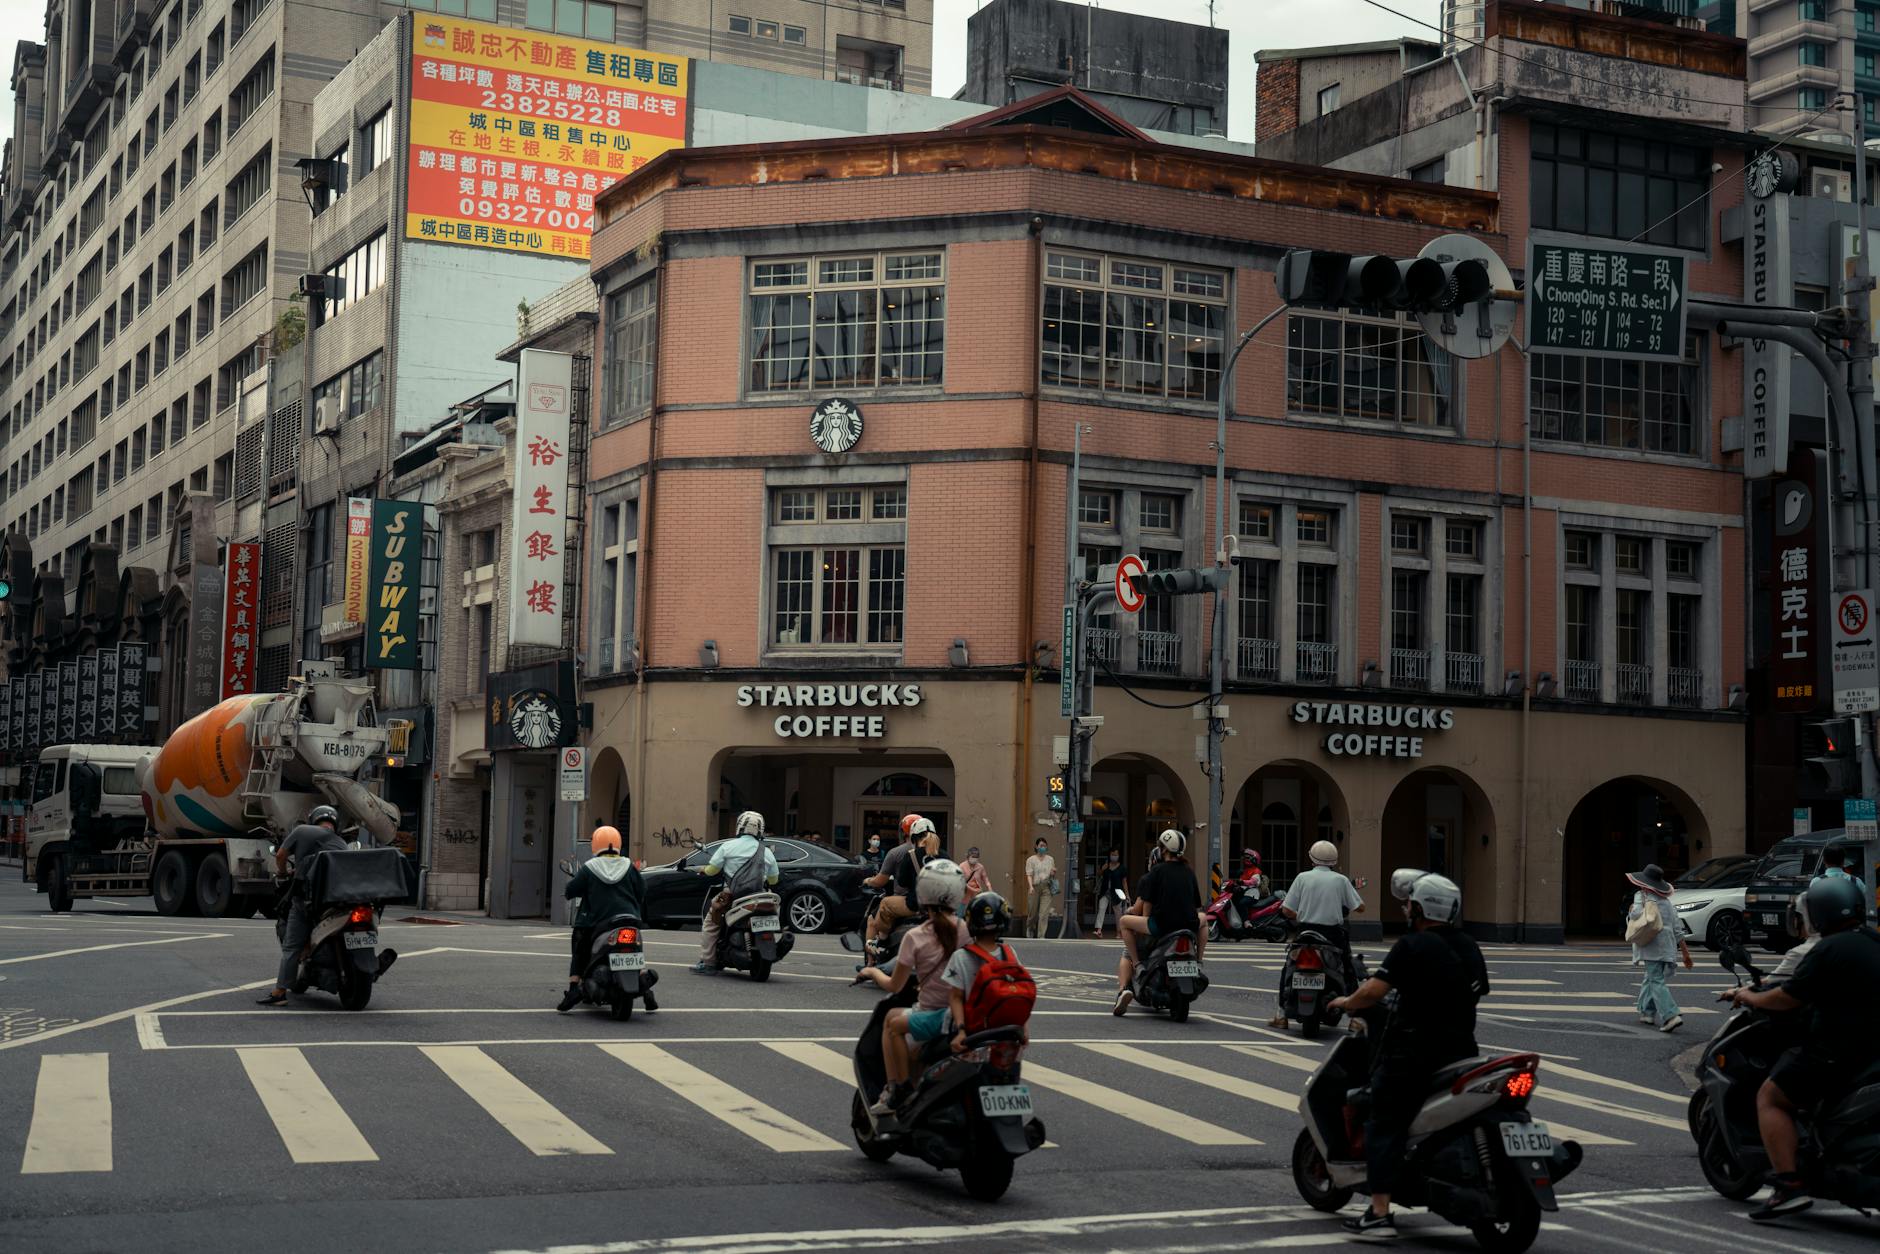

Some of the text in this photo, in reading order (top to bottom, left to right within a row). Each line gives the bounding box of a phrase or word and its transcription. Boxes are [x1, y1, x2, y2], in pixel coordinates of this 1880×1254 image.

[451, 26, 679, 88] 誠忠不動產 售租專區
[421, 60, 494, 89] 各種坪數
[481, 90, 622, 127] 23825228
[468, 112, 631, 152] 城中區租售中心
[420, 218, 543, 249] 城中區再造中心
[1544, 249, 1671, 291] 重慶南路一段
[1546, 286, 1667, 310] ChongQing S. Rd. Sec.1
[1548, 306, 1565, 324] 120
[1581, 309, 1598, 326] 106
[1617, 312, 1631, 329] 104
[1650, 315, 1662, 332] 72
[1753, 203, 1766, 458] STARBUS COFFEE
[1546, 327, 1564, 344] 147
[1580, 329, 1595, 346] 121
[1616, 332, 1630, 349] 119
[1648, 335, 1661, 351] 93
[525, 435, 563, 615] 裕生銀樓
[348, 540, 363, 623] 23825228
[379, 511, 409, 659] SUBWAY
[1780, 547, 1809, 660] 德克士
[120, 646, 143, 731] 飛哥英文
[737, 684, 921, 707] STARBUCKS
[774, 715, 884, 738] COFFEE
[1294, 701, 1455, 730] STARBUCKS
[324, 742, 365, 757] KEA-8079
[1327, 733, 1424, 758] COFFEE
[1049, 777, 1063, 791] 55
[983, 1095, 1031, 1111] 010-KNN
[1504, 1134, 1551, 1151] 761-EXD
